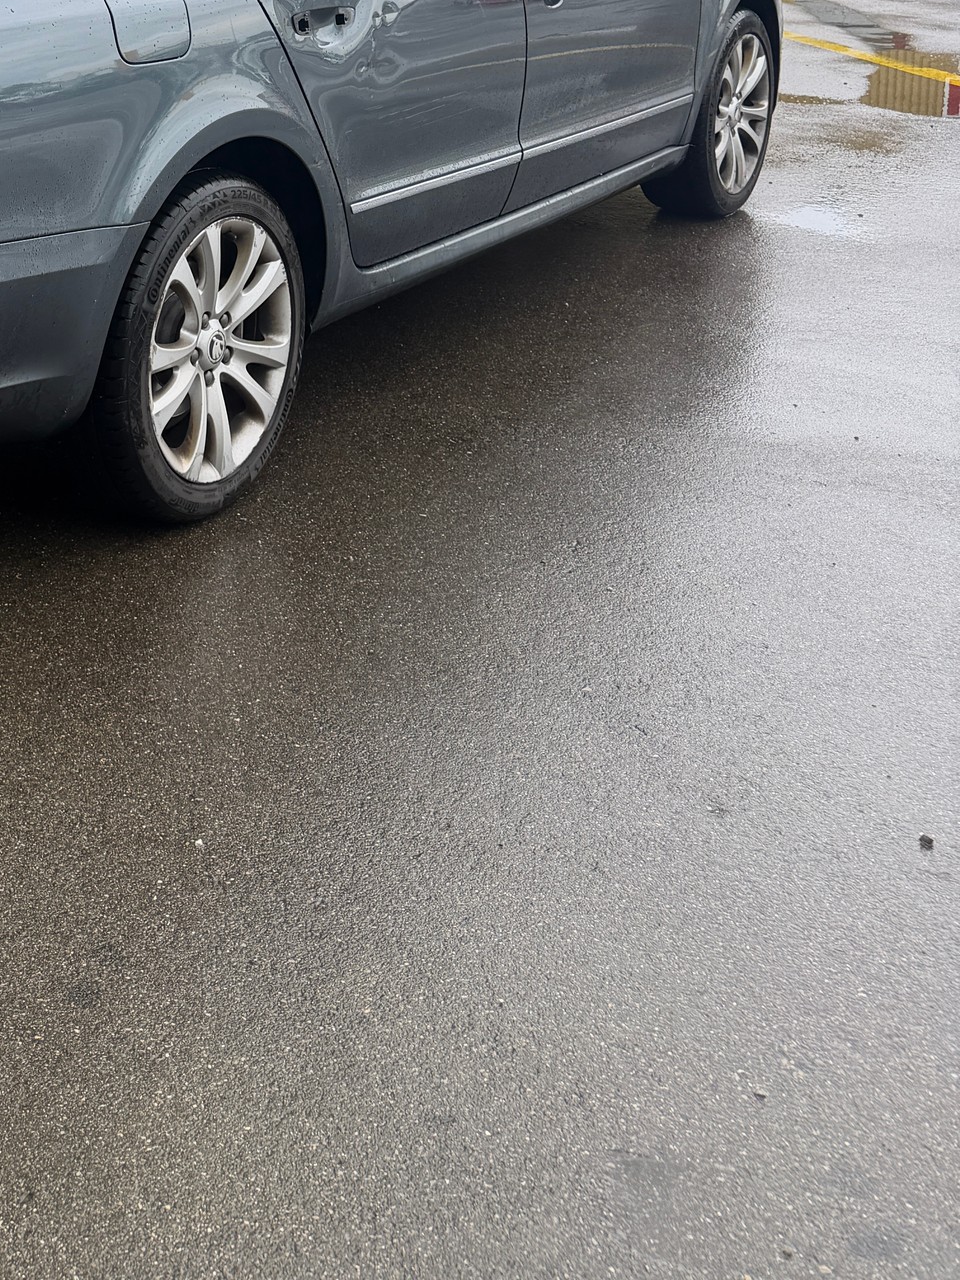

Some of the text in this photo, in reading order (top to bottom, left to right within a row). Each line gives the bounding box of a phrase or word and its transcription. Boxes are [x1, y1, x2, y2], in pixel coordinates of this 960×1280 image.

[230, 189, 262, 204] 225/45
[147, 227, 192, 305] Continental
[260, 388, 294, 466] Continental
